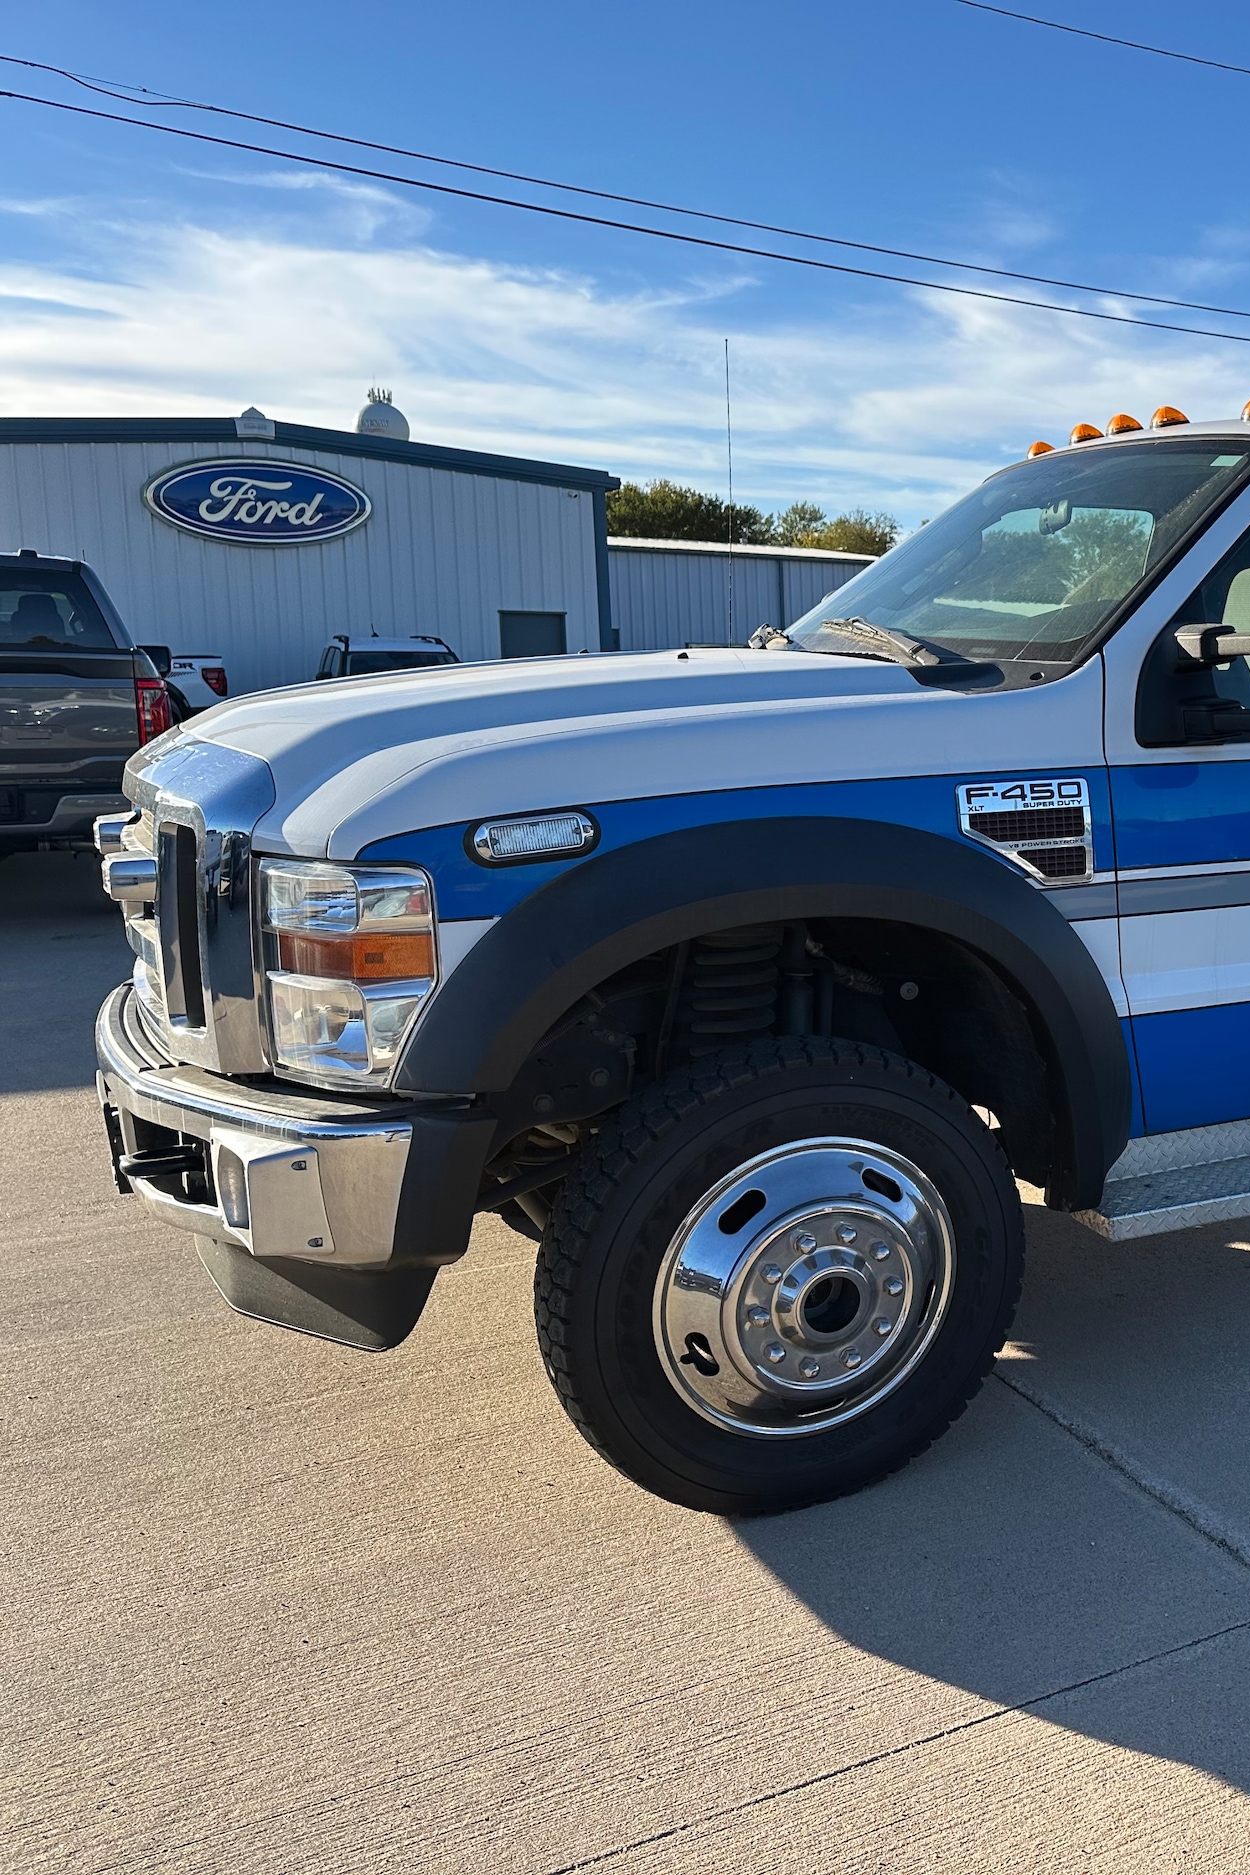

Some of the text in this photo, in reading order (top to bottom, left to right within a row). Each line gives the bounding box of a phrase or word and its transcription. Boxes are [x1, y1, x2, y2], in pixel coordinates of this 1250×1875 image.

[198, 476, 325, 526] Ford
[965, 781, 1082, 804] F-450
[1023, 799, 1083, 809] SUPER DUTY
